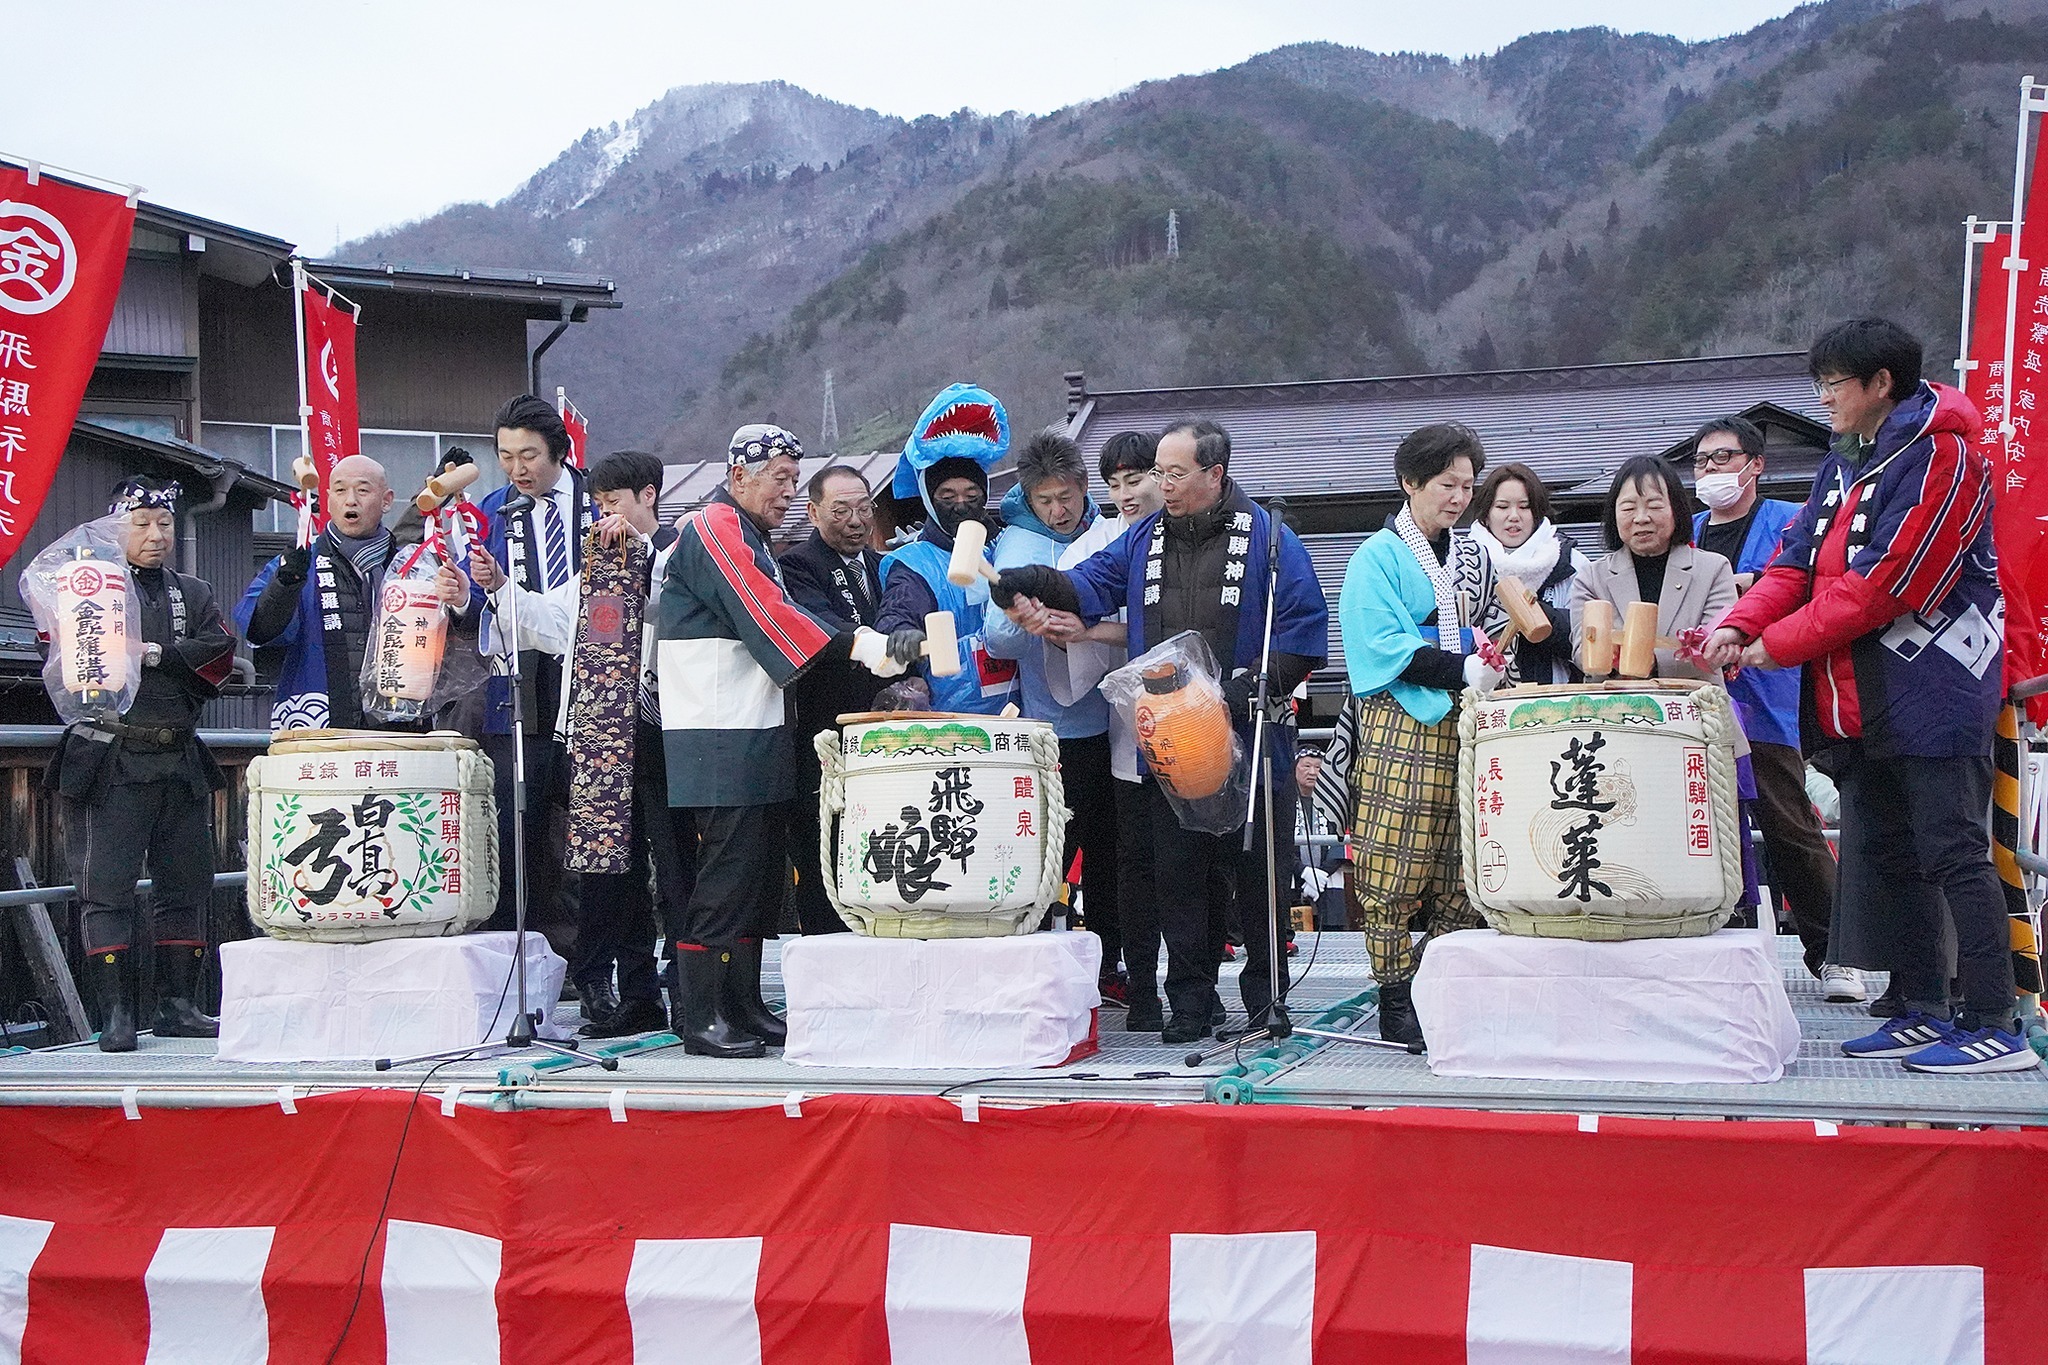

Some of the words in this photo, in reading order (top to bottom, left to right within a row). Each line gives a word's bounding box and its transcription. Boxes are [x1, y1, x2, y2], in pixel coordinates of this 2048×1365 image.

[1220, 511, 1252, 607] 飛騨神岡
[415, 616, 428, 648] 神岡
[298, 762, 338, 782] 登録
[354, 760, 400, 779] 商標
[994, 732, 1031, 752] 商標
[929, 766, 984, 875] 飛騨
[1686, 753, 1709, 849] 飛騨の酒
[439, 791, 461, 894] 飛騨の酒
[316, 911, 380, 922] シラマユミ
